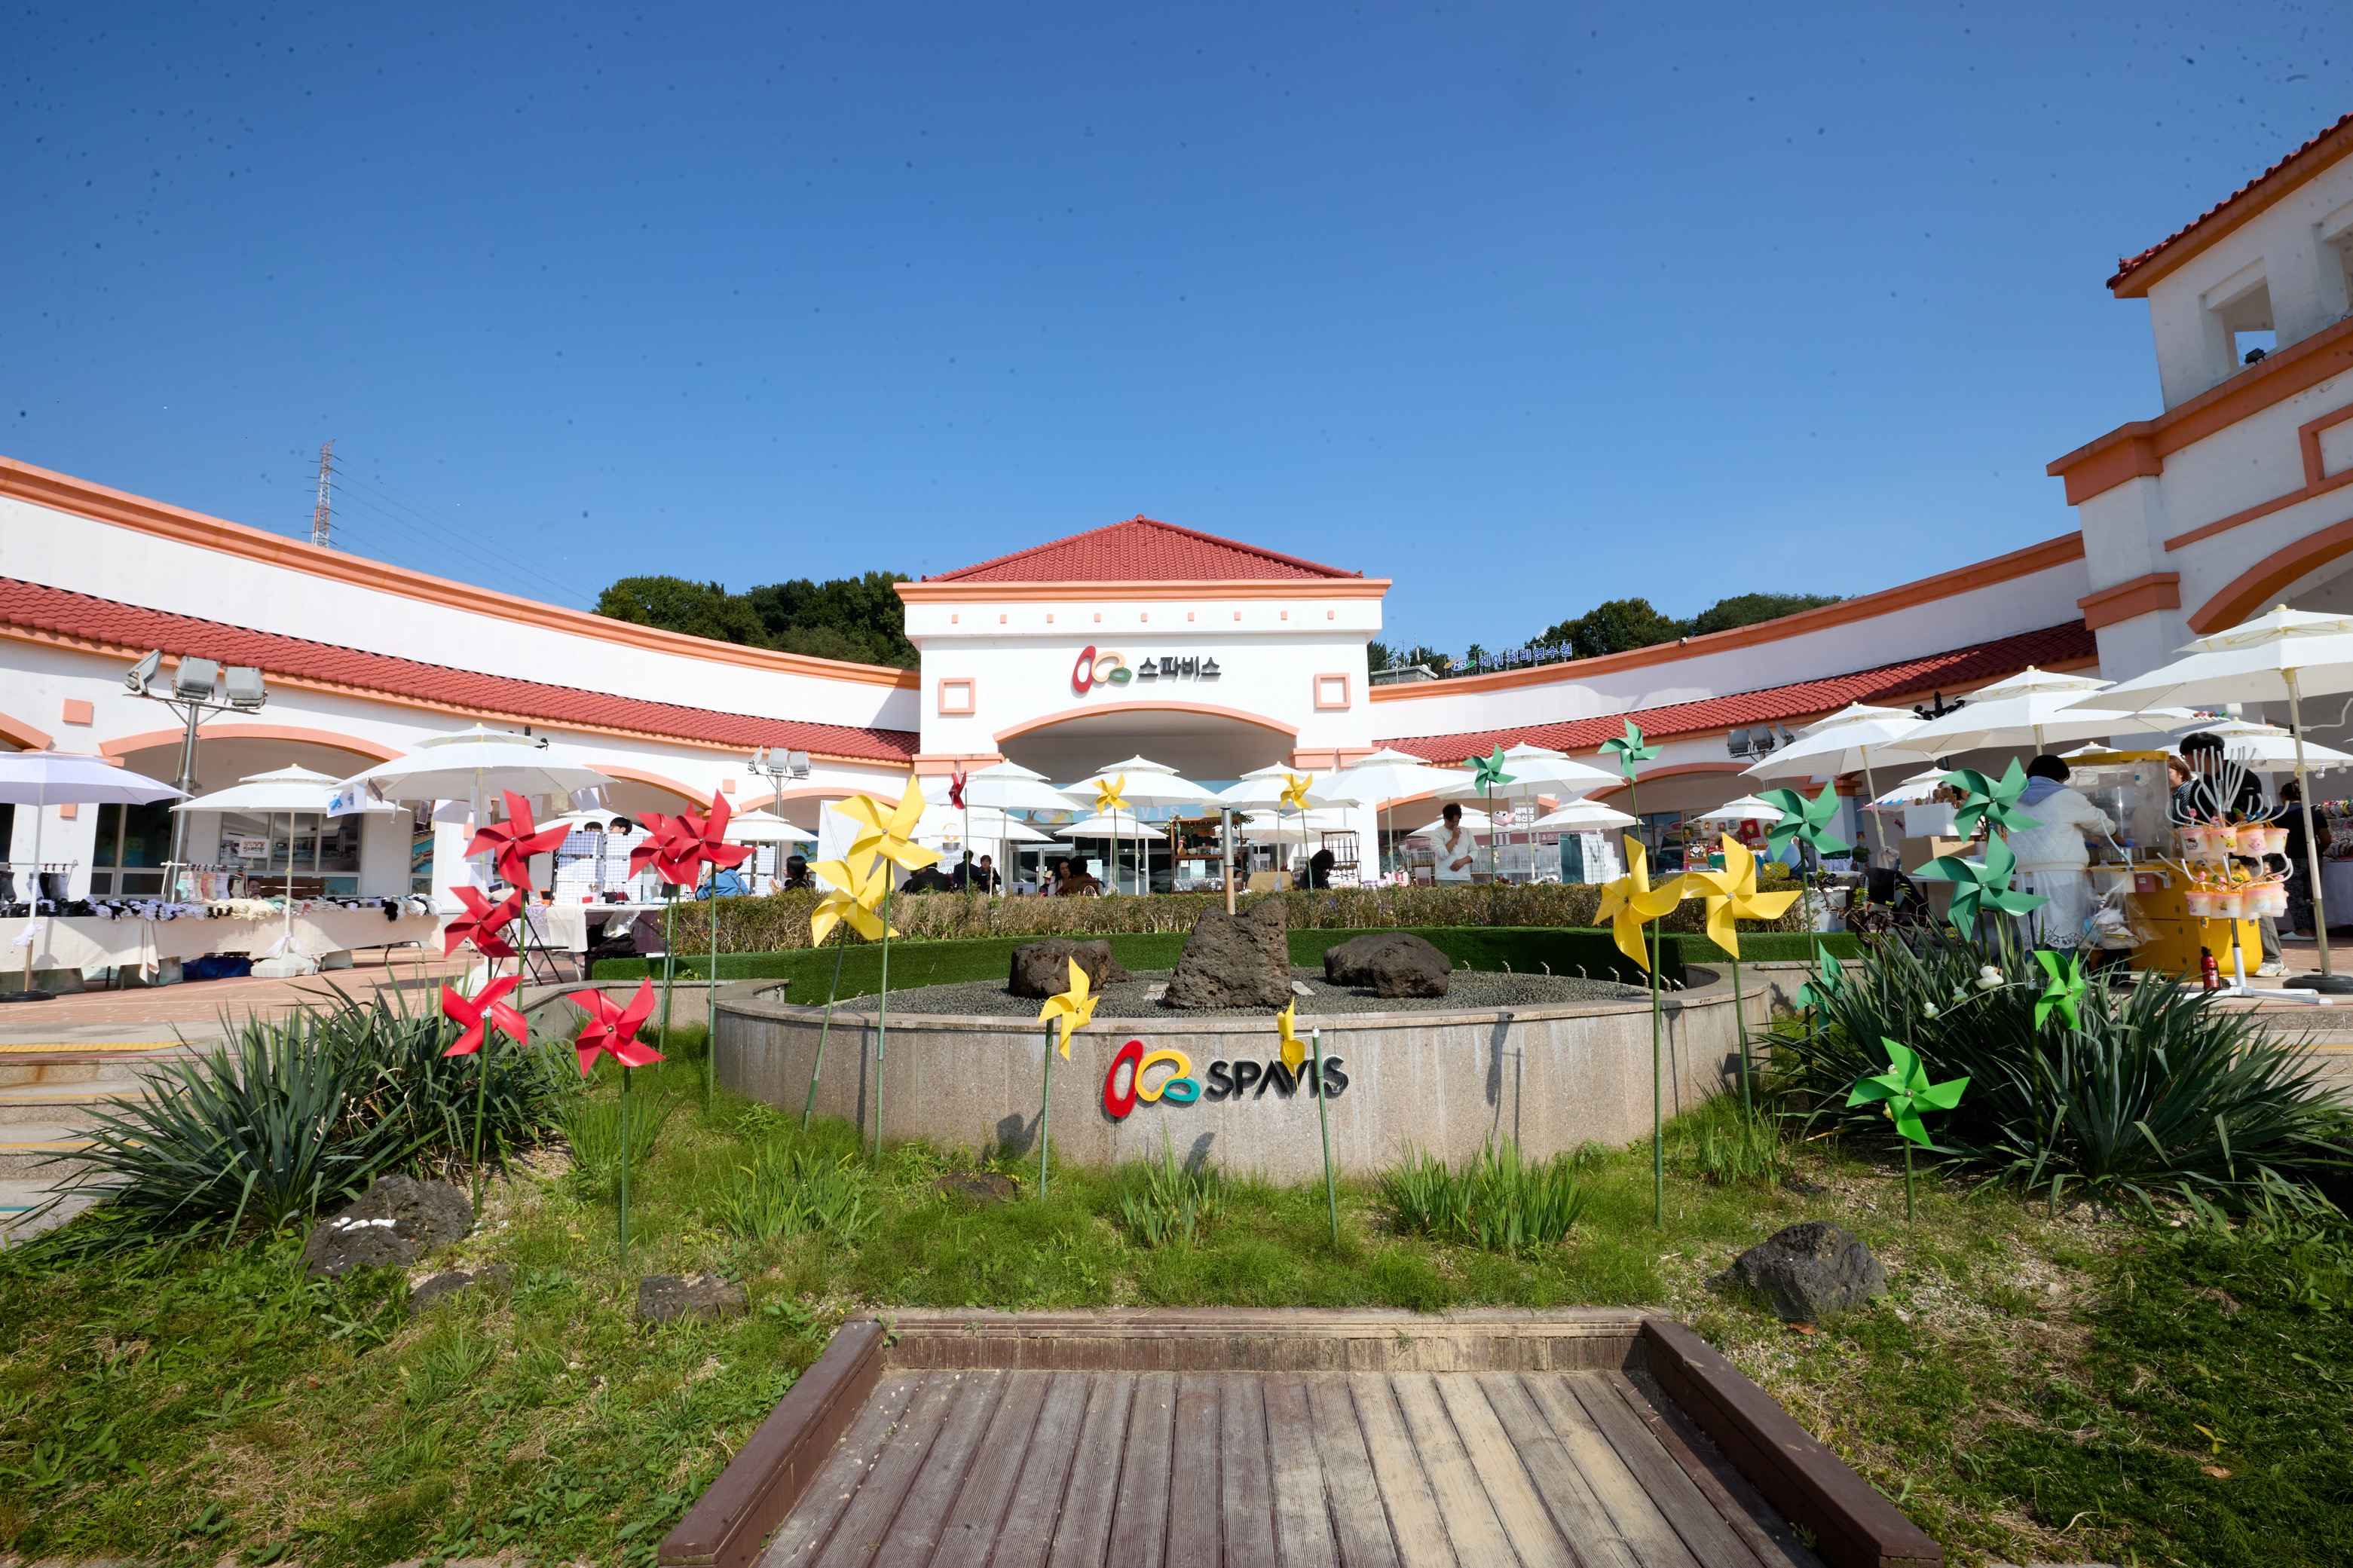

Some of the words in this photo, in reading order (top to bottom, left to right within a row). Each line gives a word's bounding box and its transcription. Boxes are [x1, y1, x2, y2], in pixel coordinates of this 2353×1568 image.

[1138, 656, 1221, 677] 스파비스
[1479, 643, 1572, 667] 에이치비연수원
[1207, 1056, 1348, 1100] SPAVIS
